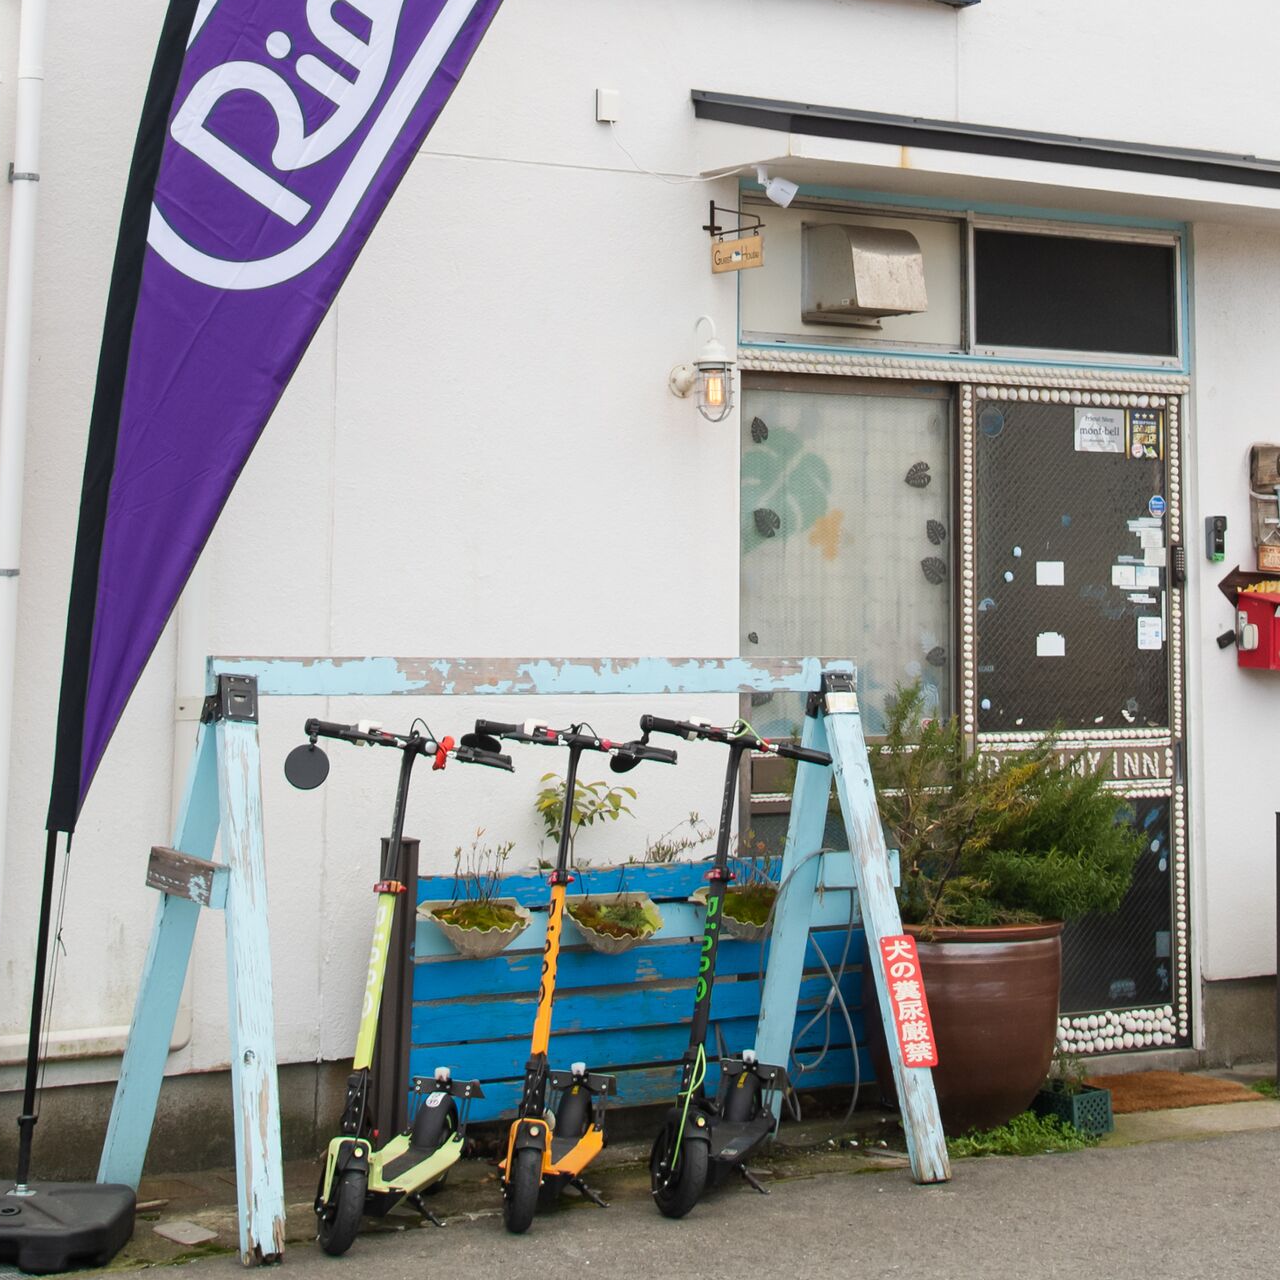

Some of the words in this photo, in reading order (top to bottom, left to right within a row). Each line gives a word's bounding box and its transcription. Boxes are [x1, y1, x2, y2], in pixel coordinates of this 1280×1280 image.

[884, 939, 934, 1063] 犬の糞尿厳禁
